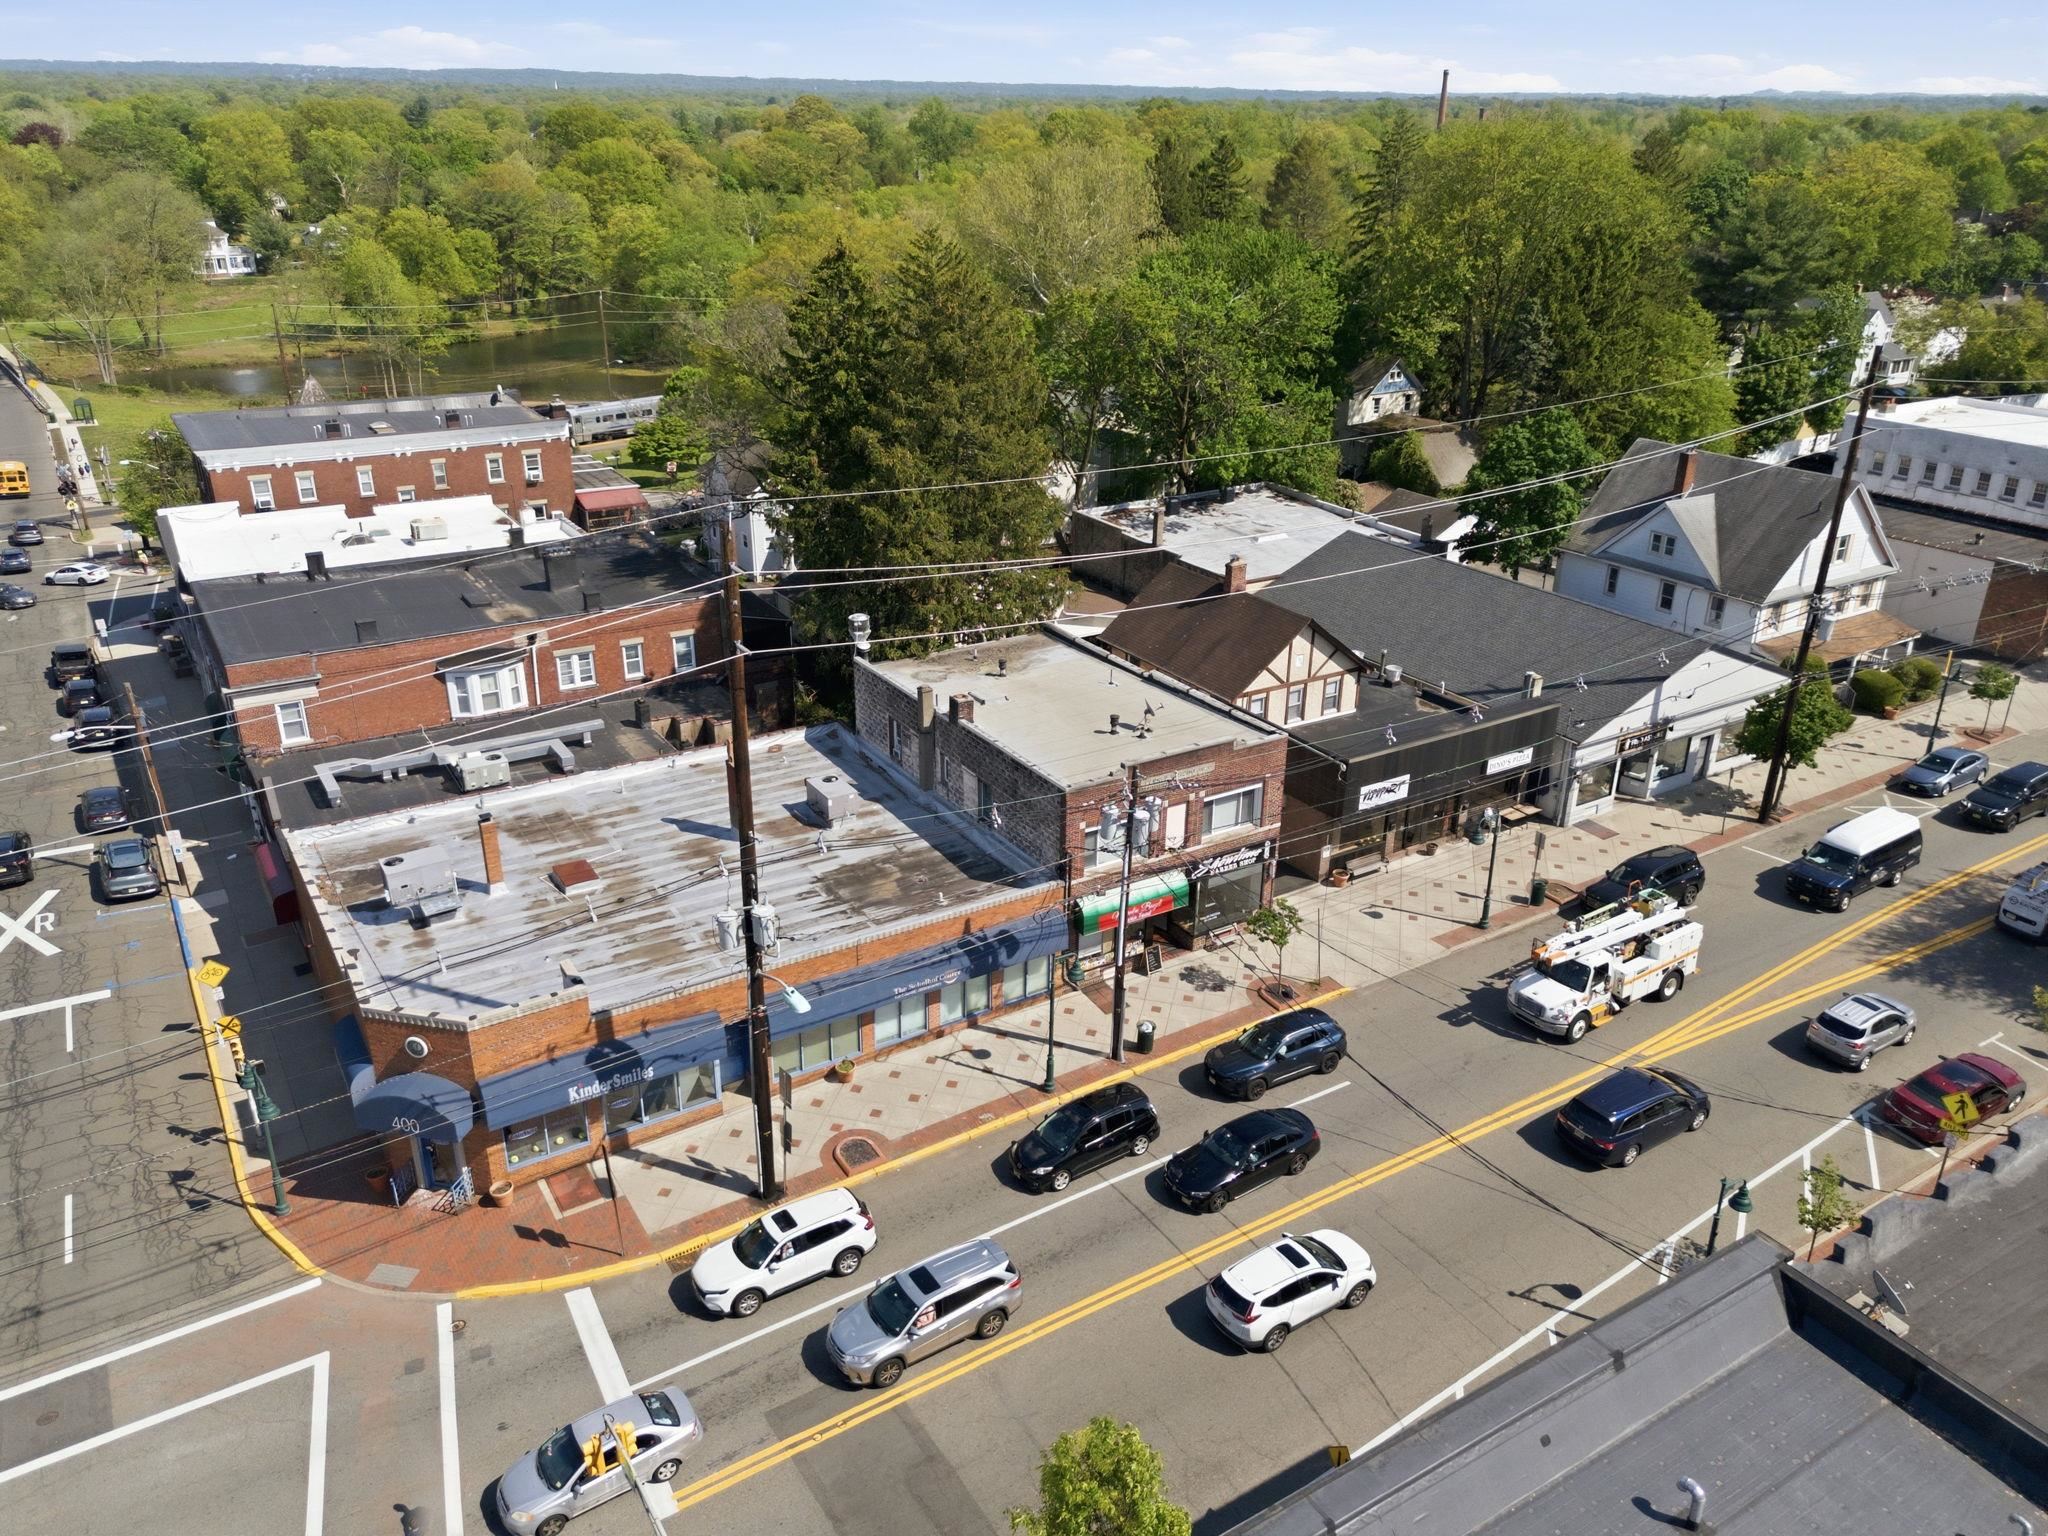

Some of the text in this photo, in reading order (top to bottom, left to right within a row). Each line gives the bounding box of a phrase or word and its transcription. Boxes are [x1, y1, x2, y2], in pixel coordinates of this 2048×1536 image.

[1512, 752, 1531, 763] PIZZA
[1239, 857, 1257, 868] SHOP
[35, 912, 55, 934] R
[568, 1066, 654, 1102] KinderSmiles
[392, 1116, 420, 1133] 400
